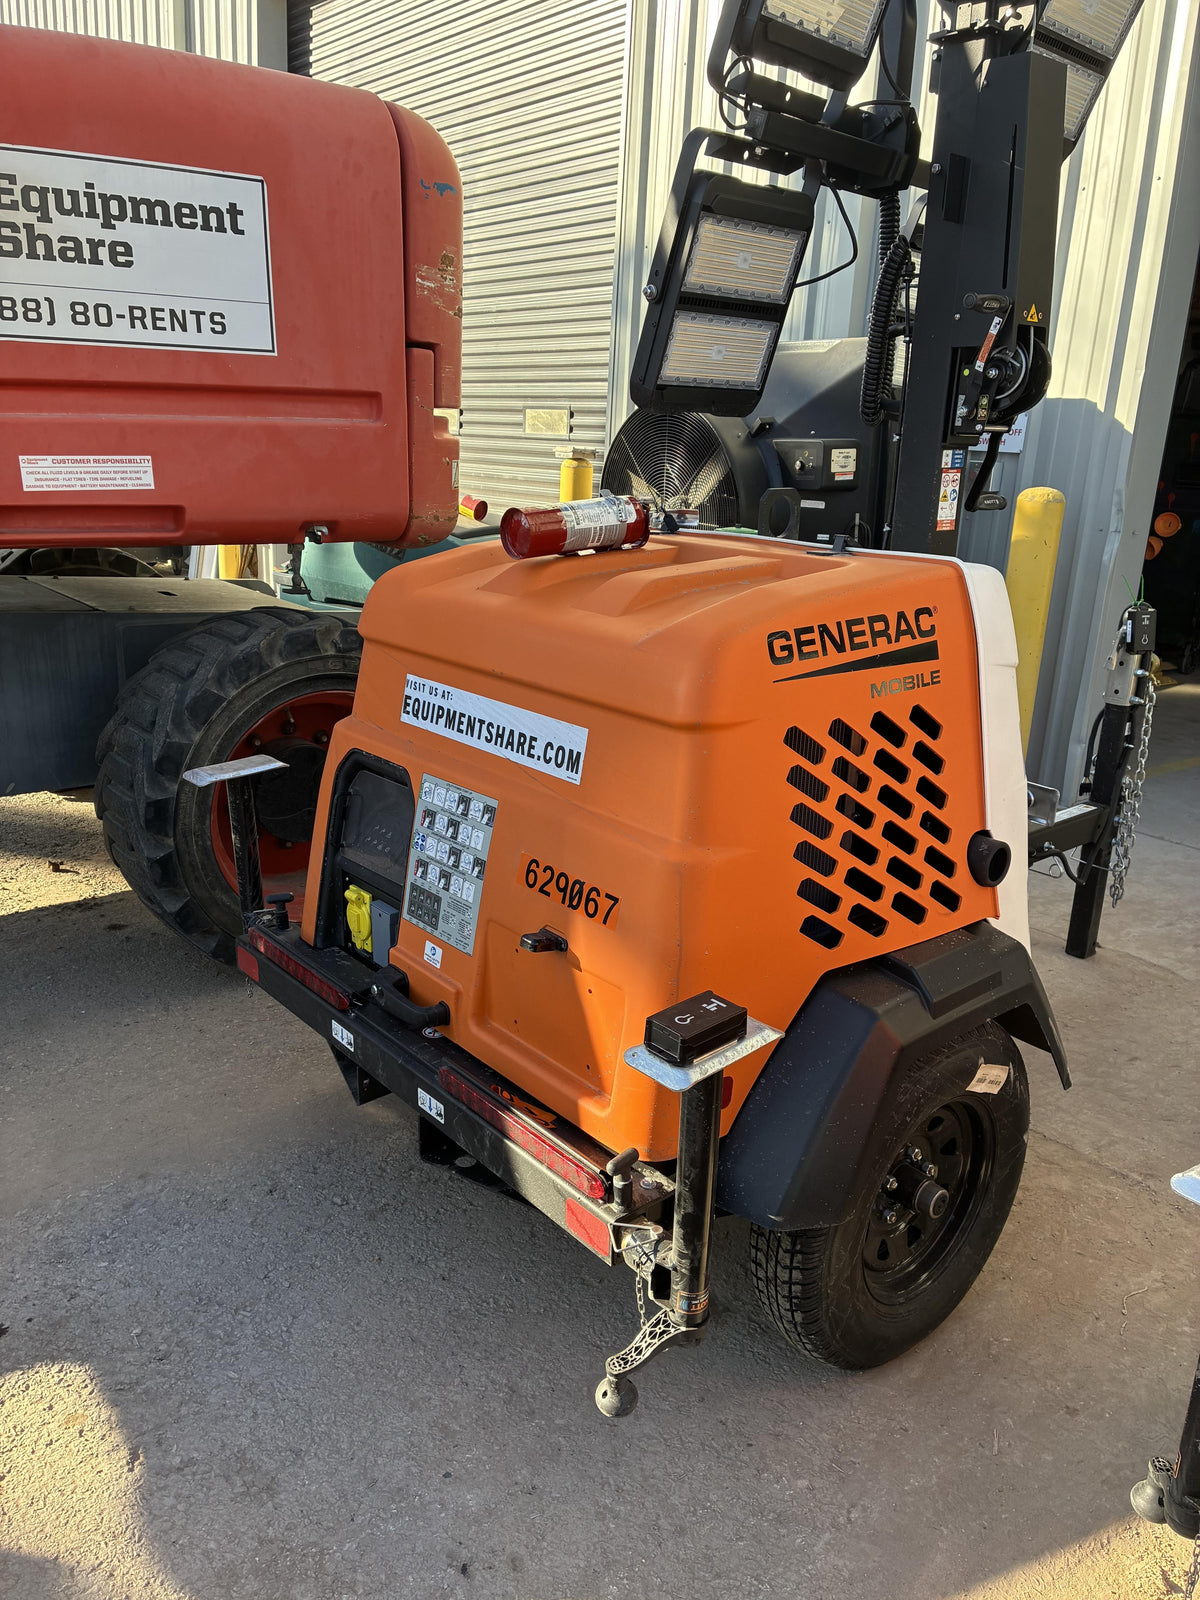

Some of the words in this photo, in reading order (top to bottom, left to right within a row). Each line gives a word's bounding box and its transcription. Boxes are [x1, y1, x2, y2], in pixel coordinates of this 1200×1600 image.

[0, 172, 245, 235] Equipment
[0, 221, 134, 268] Share
[69, 300, 227, 335] 80-RENTS
[766, 606, 936, 666] GENERAC
[428, 685, 439, 697] US
[441, 689, 453, 701] AT:
[870, 669, 941, 699] MOBILE
[402, 694, 582, 775] EQUIPMENTSHARE.COM
[525, 858, 620, 926] 629067
